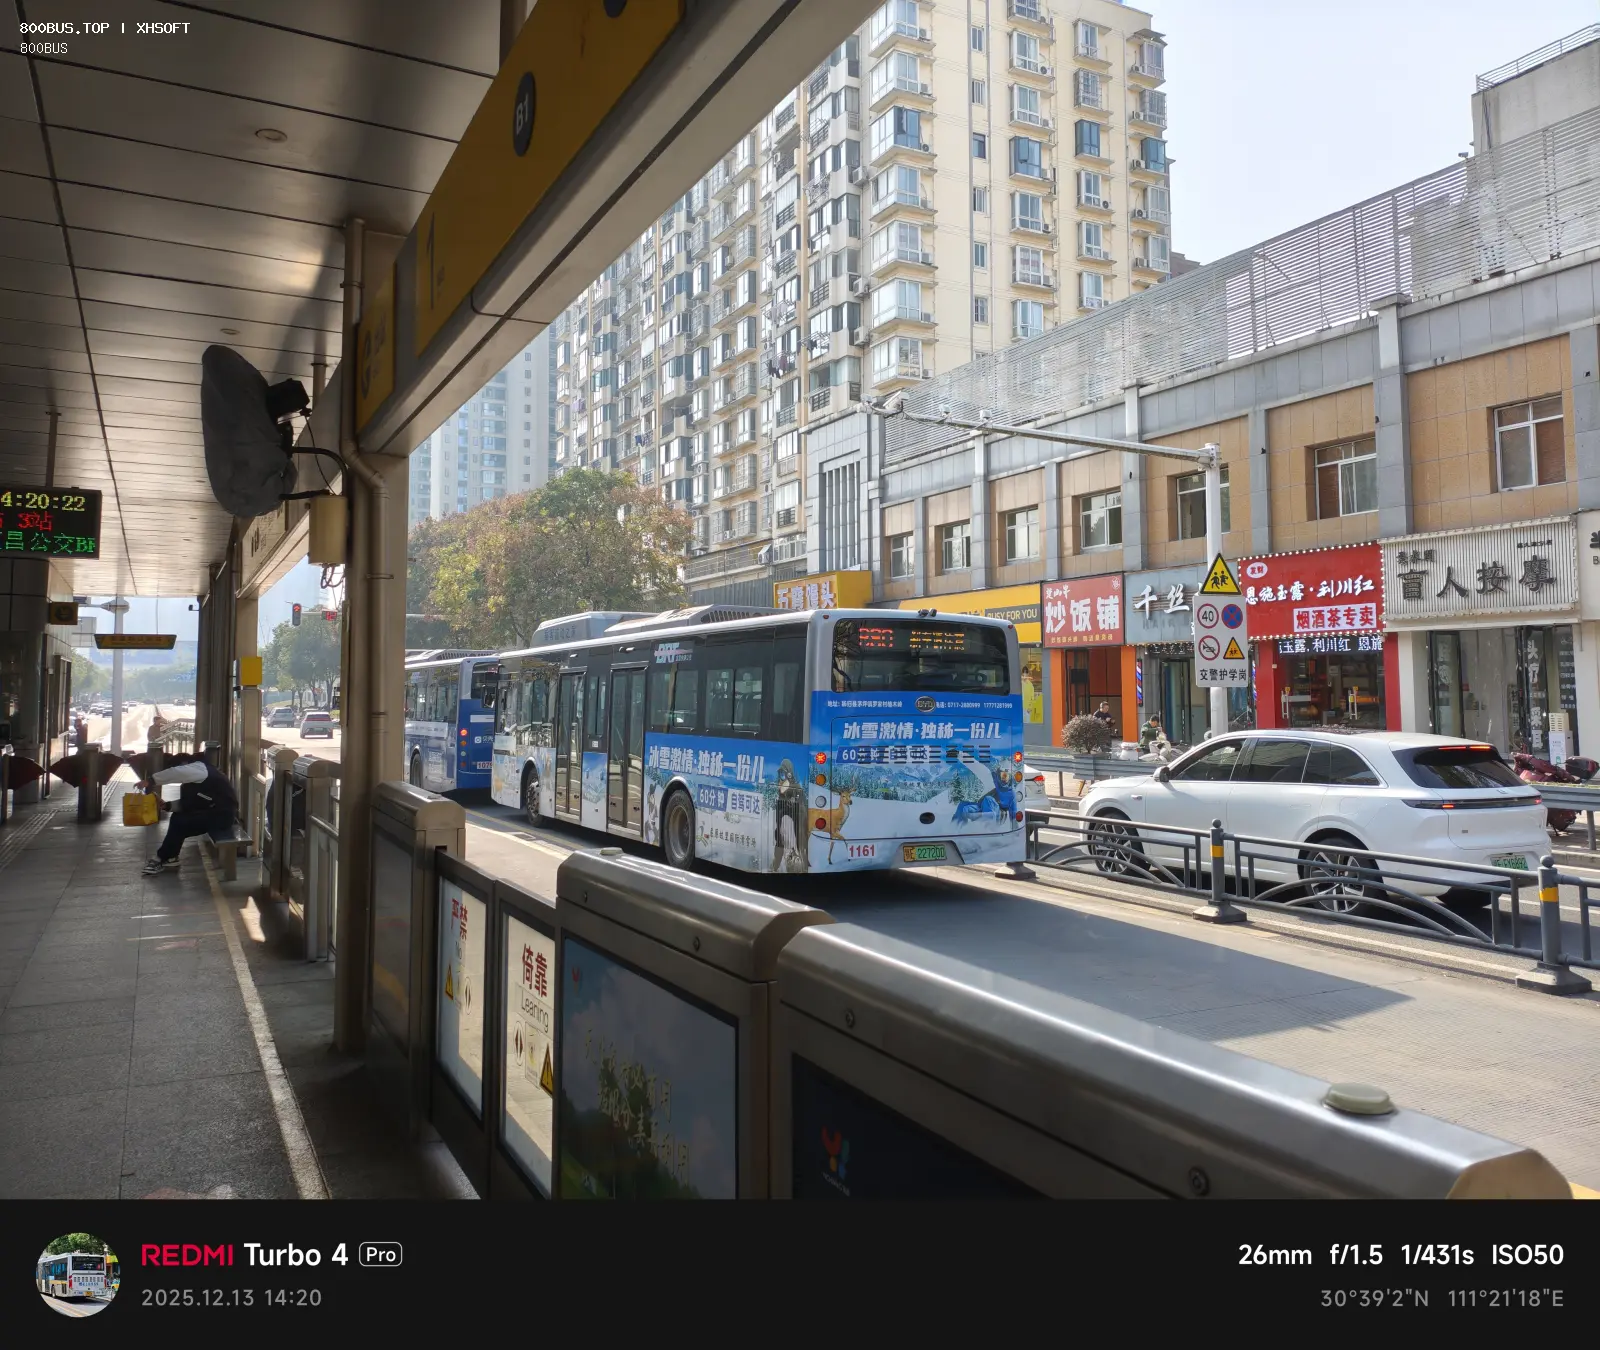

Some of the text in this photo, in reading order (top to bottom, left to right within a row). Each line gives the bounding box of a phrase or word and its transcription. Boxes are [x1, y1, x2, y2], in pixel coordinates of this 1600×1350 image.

[515, 93, 531, 136] B1
[1397, 555, 1557, 600] 盲人按摩
[1007, 610, 1021, 620] FOR
[1022, 608, 1038, 619] YOU
[1045, 594, 1120, 633] 炒饭铺
[1134, 583, 1202, 620] 千丝
[1202, 610, 1214, 622] 40
[1296, 605, 1374, 630] 烟酒茶专卖
[1199, 668, 1247, 682] 交警护学岗
[699, 786, 726, 807] 60分钟
[849, 844, 875, 857] 1161
[450, 898, 468, 941] 严禁
[521, 943, 548, 998] 倚靠
[520, 993, 550, 1034] Leaning
